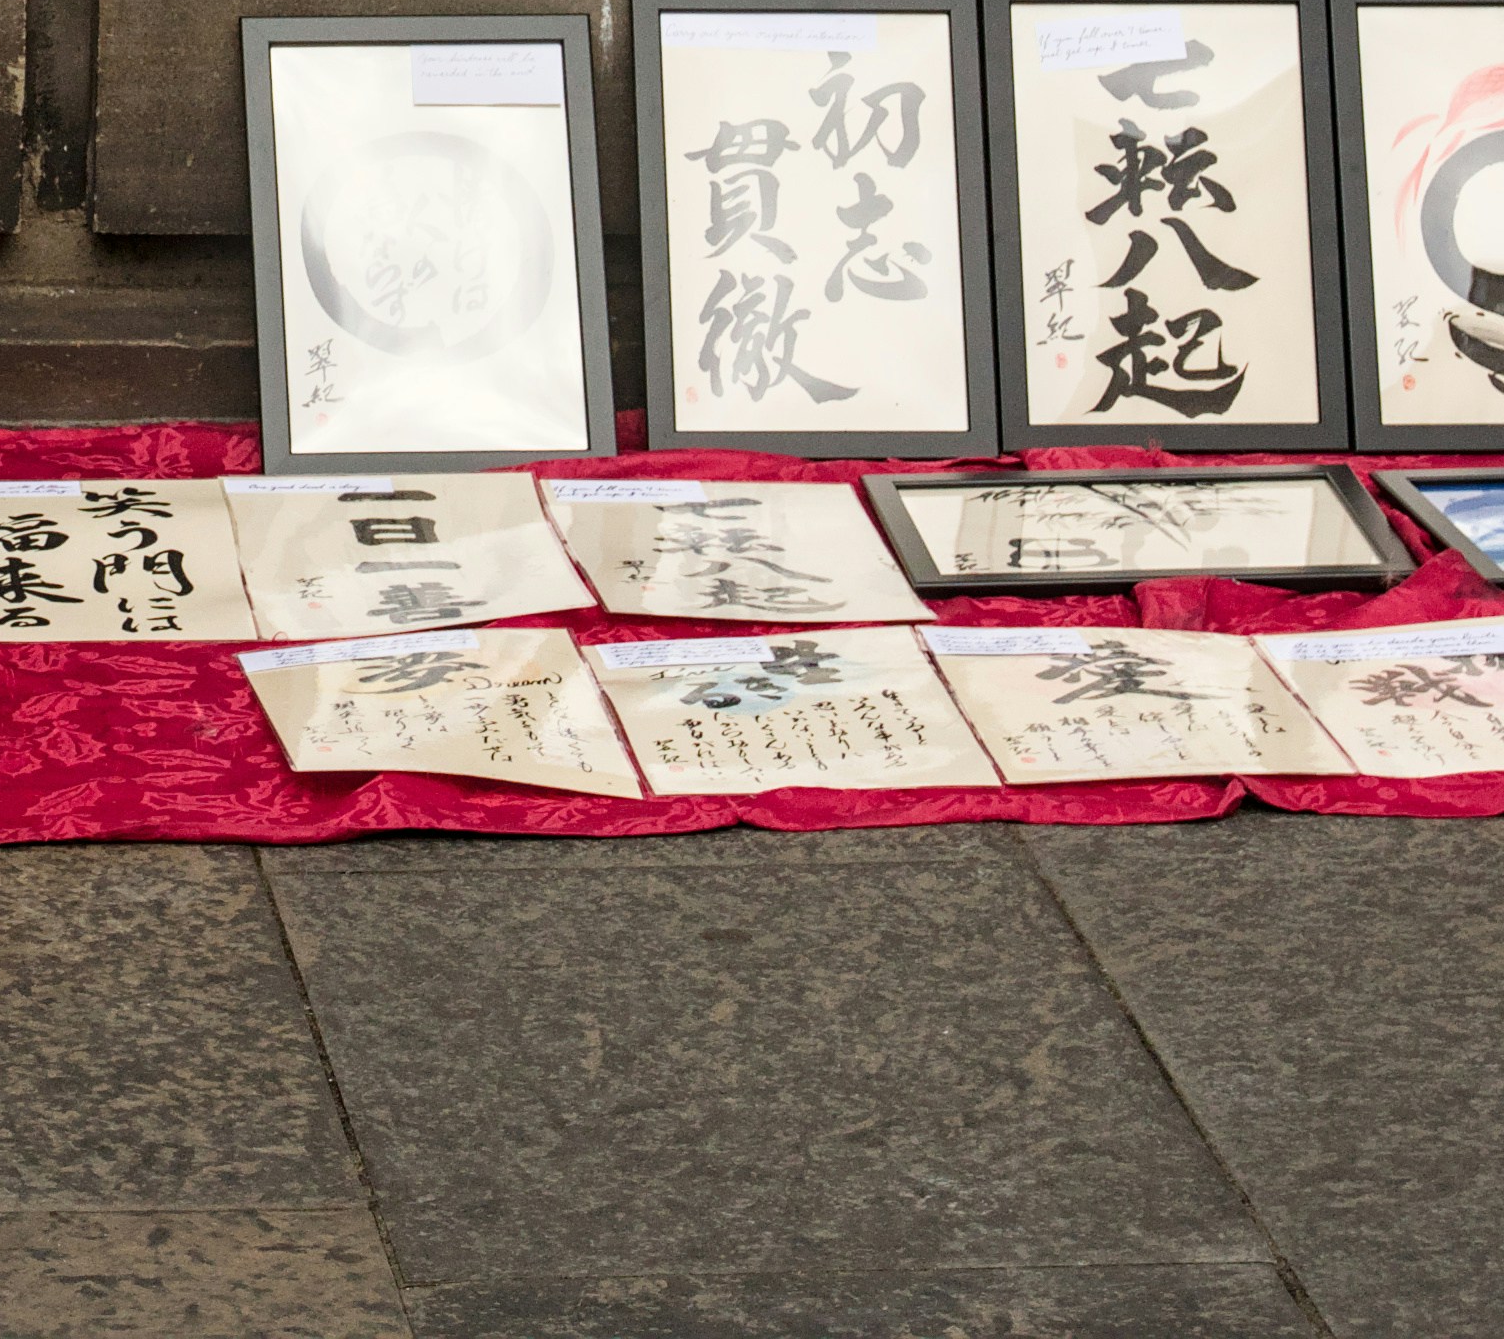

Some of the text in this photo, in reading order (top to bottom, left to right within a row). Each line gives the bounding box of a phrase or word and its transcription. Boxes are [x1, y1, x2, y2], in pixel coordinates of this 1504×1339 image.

[684, 118, 860, 405] 貫徹
[808, 50, 933, 303] 初志
[1084, 39, 1260, 419] 七転八起
[79, 486, 195, 634] 笑う門には
[337, 488, 490, 625] 一日一善
[652, 497, 848, 613] 七転八起
